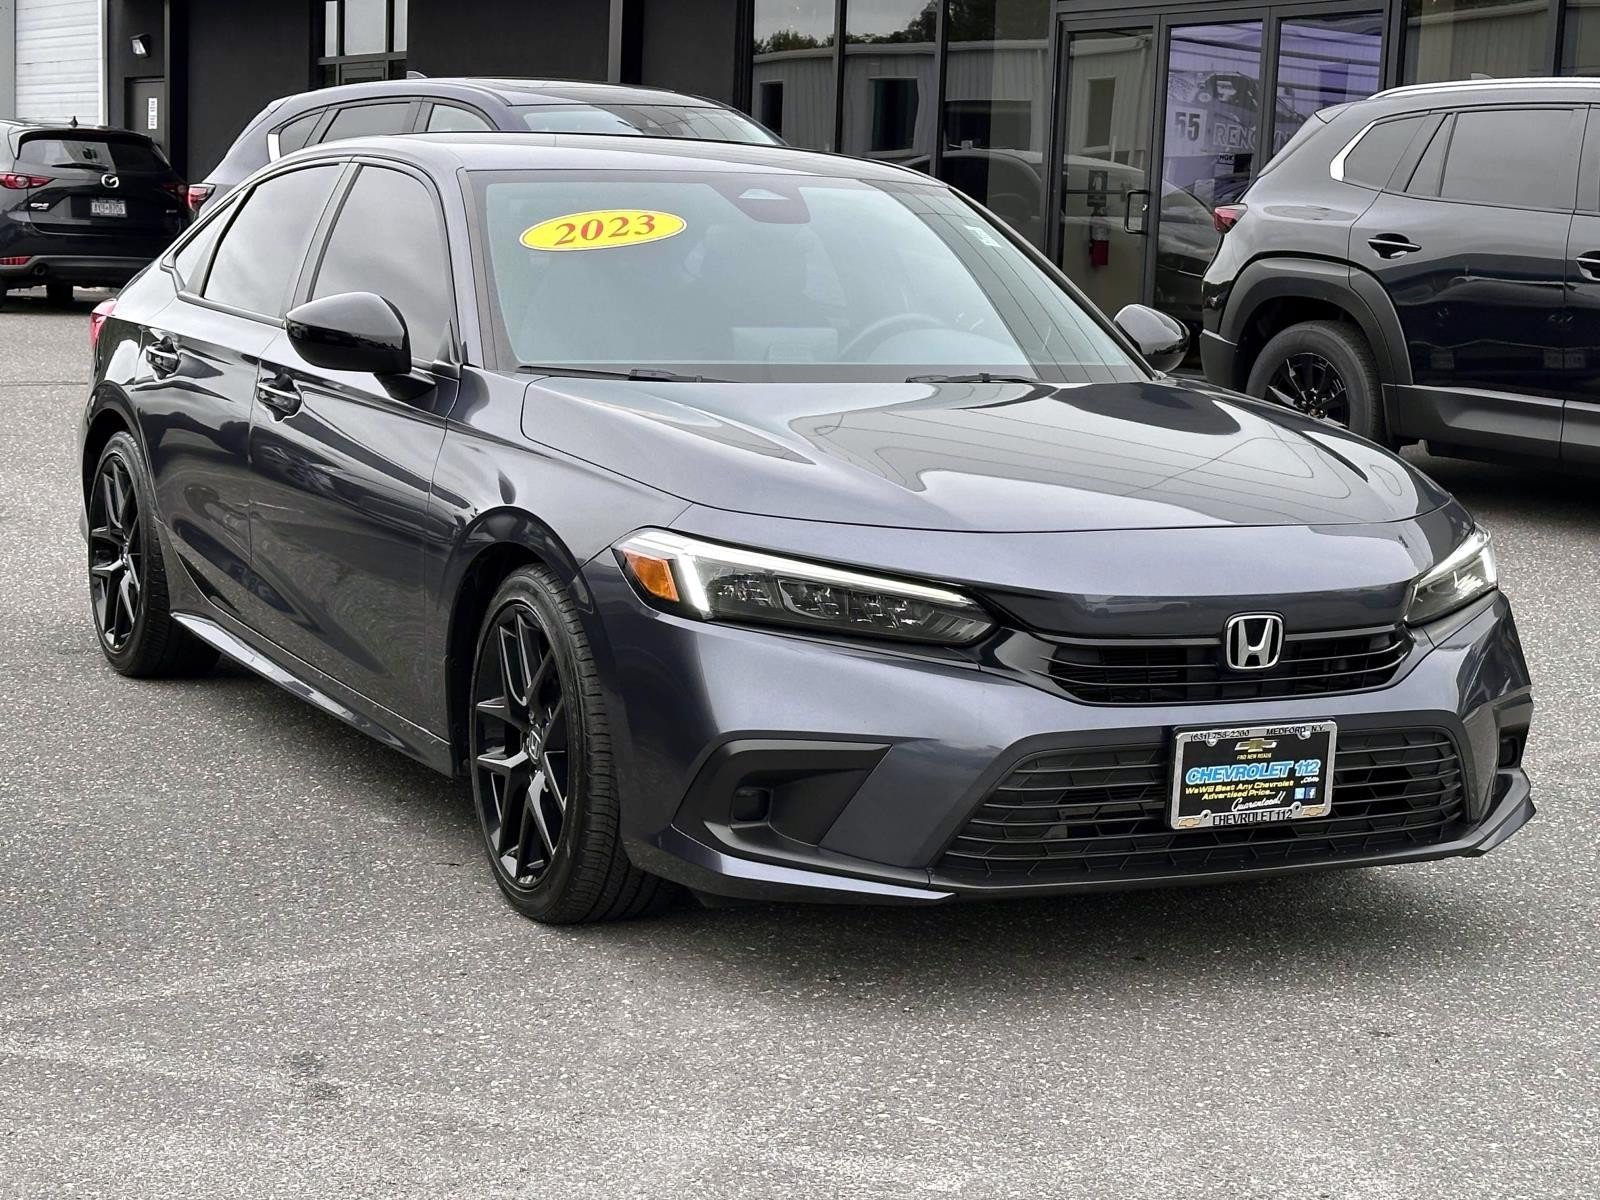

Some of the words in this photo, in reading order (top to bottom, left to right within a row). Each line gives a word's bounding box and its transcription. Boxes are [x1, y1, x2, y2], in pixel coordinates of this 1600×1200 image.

[554, 214, 656, 246] 2023
[1186, 761, 1294, 784] CHEVROLET
[1294, 759, 1321, 776] 112
[1199, 785, 1214, 793] Will
[1215, 784, 1235, 792] Beat
[1236, 783, 1253, 791] Any
[1253, 780, 1294, 789] Chevrolet
[1201, 790, 1248, 800] Advertised
[1213, 811, 1275, 826] CHEVROLET
[1276, 808, 1293, 820] 112
